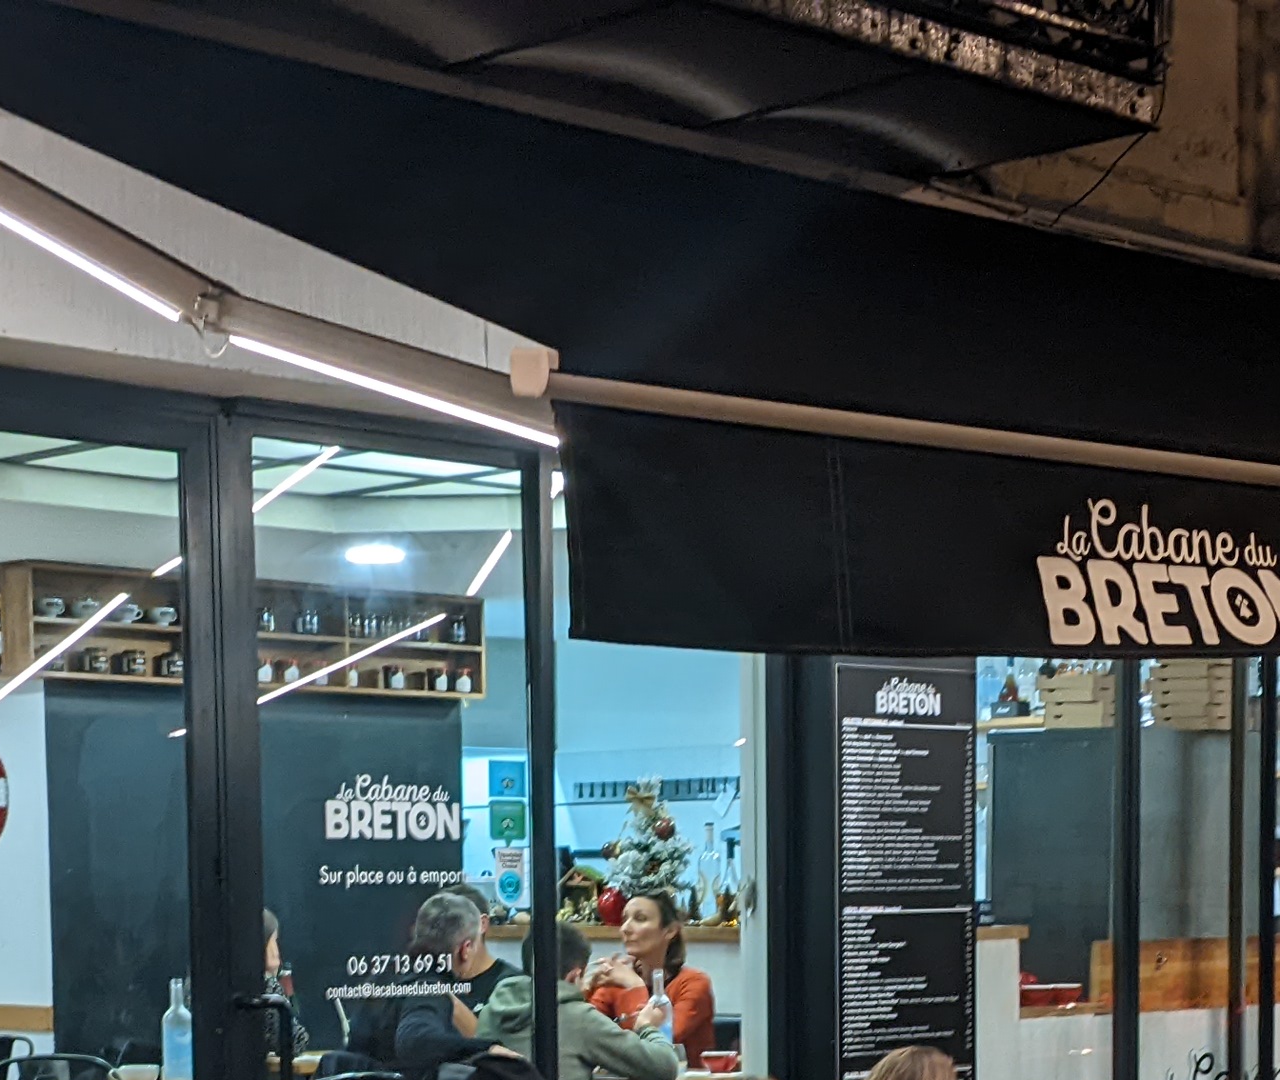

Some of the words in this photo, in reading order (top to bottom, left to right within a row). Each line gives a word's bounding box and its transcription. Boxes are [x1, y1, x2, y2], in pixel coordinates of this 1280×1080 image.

[1056, 514, 1091, 562] La
[1087, 497, 1240, 566] Cabane
[1244, 532, 1278, 567] du
[875, 691, 941, 716] BRETON
[336, 782, 355, 801] La
[355, 774, 431, 802] Cabane
[432, 785, 451, 802] du
[325, 800, 461, 840] BRETON
[319, 864, 343, 884] Sur
[345, 864, 384, 889] place
[386, 870, 404, 884] ou
[406, 866, 417, 884] à
[419, 867, 467, 888] empor
[347, 955, 368, 976] 06
[370, 954, 391, 975] 37
[393, 953, 411, 974] 13
[413, 953, 433, 974] 69
[436, 952, 453, 973] 51
[325, 980, 472, 1000] contact@lacabanedubreton.com
